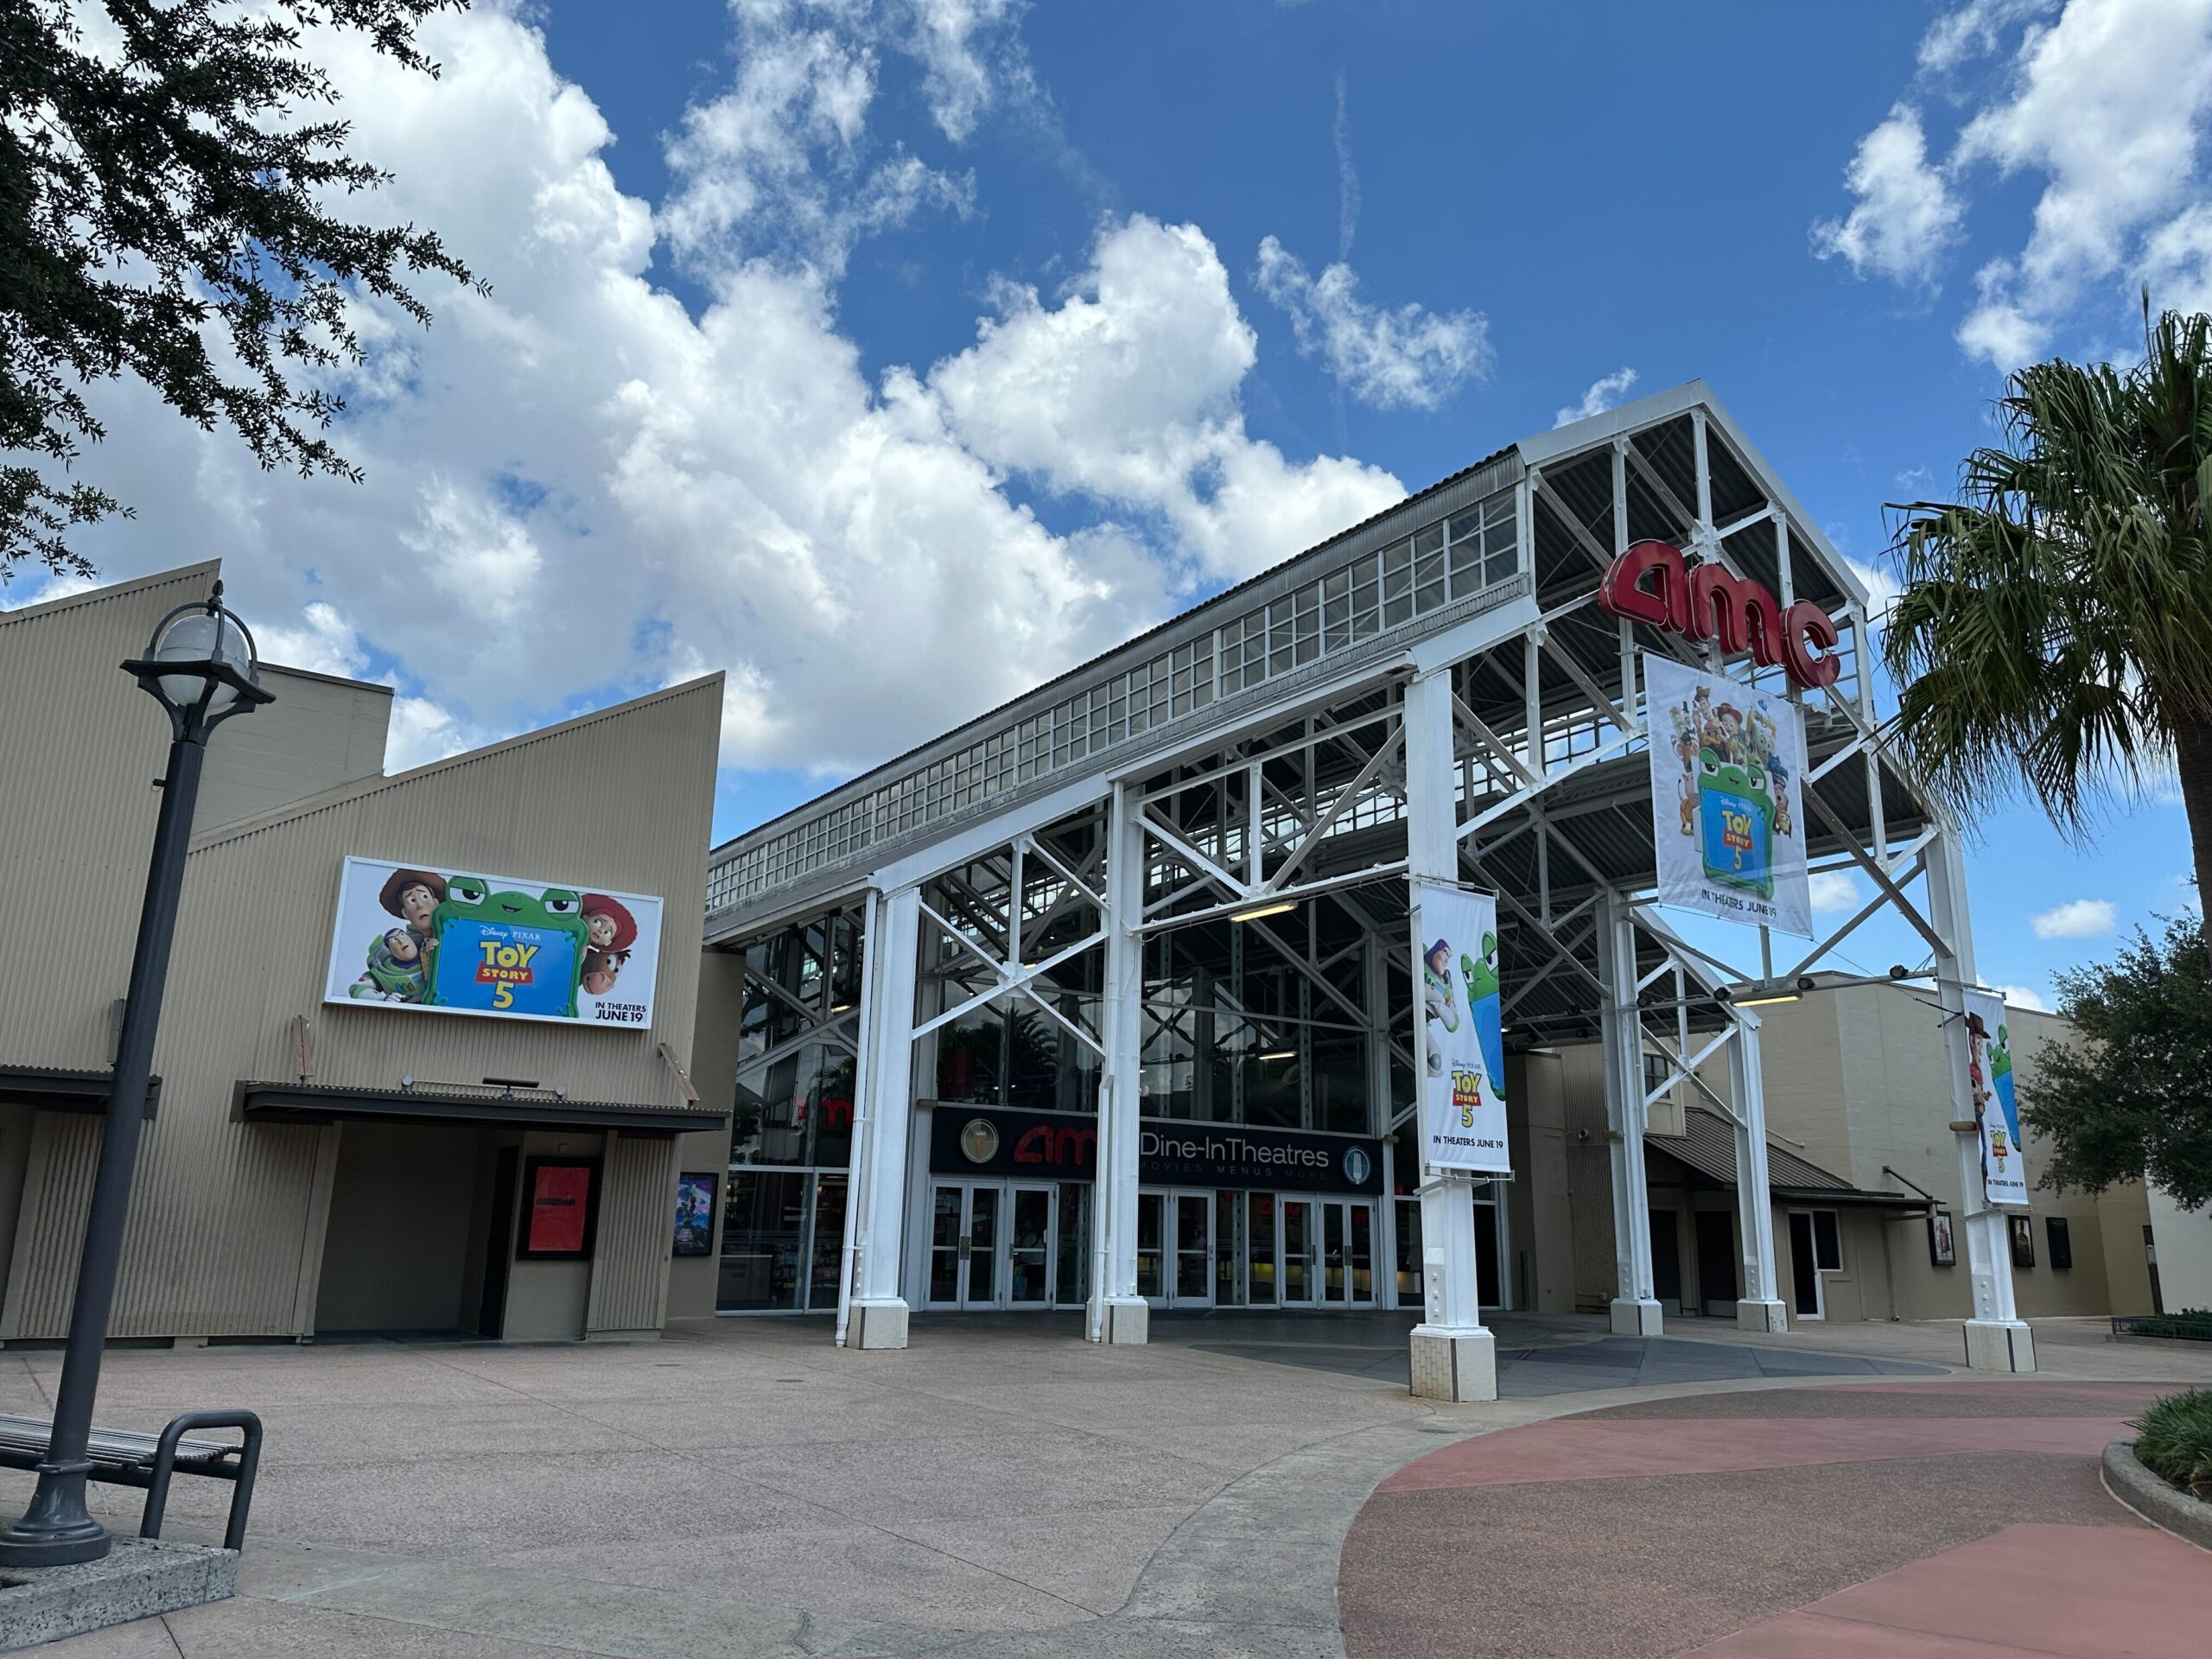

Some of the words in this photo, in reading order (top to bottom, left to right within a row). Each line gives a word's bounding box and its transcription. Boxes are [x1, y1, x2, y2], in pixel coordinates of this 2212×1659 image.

[1721, 810, 1752, 836] TOY
[1726, 834, 1751, 847] STORY
[1734, 847, 1742, 869] 5
[1701, 889, 1711, 900] IN
[1711, 892, 1744, 910] THEATERS
[1747, 901, 1768, 915] JUNE
[1768, 906, 1777, 918] 19
[479, 925, 508, 939] Disney
[512, 931, 541, 940] PIXAR
[480, 940, 542, 969] TOY
[482, 968, 529, 980] STORY
[492, 980, 515, 1008] 5
[607, 1002, 646, 1012] THEATERS
[595, 1009, 628, 1021] JUNE
[631, 1012, 643, 1022] 19
[1452, 1071, 1482, 1094] TOY
[1455, 1094, 1478, 1103] STORY
[1461, 1104, 1473, 1128] 5
[1013, 1125, 1097, 1165] am
[1433, 1135, 1441, 1144] IN
[1443, 1135, 1475, 1147] THEATERS
[1477, 1139, 1494, 1148] JUNE
[1990, 1130, 2006, 1146] TOY
[1217, 1165, 1272, 1177] MENUS
